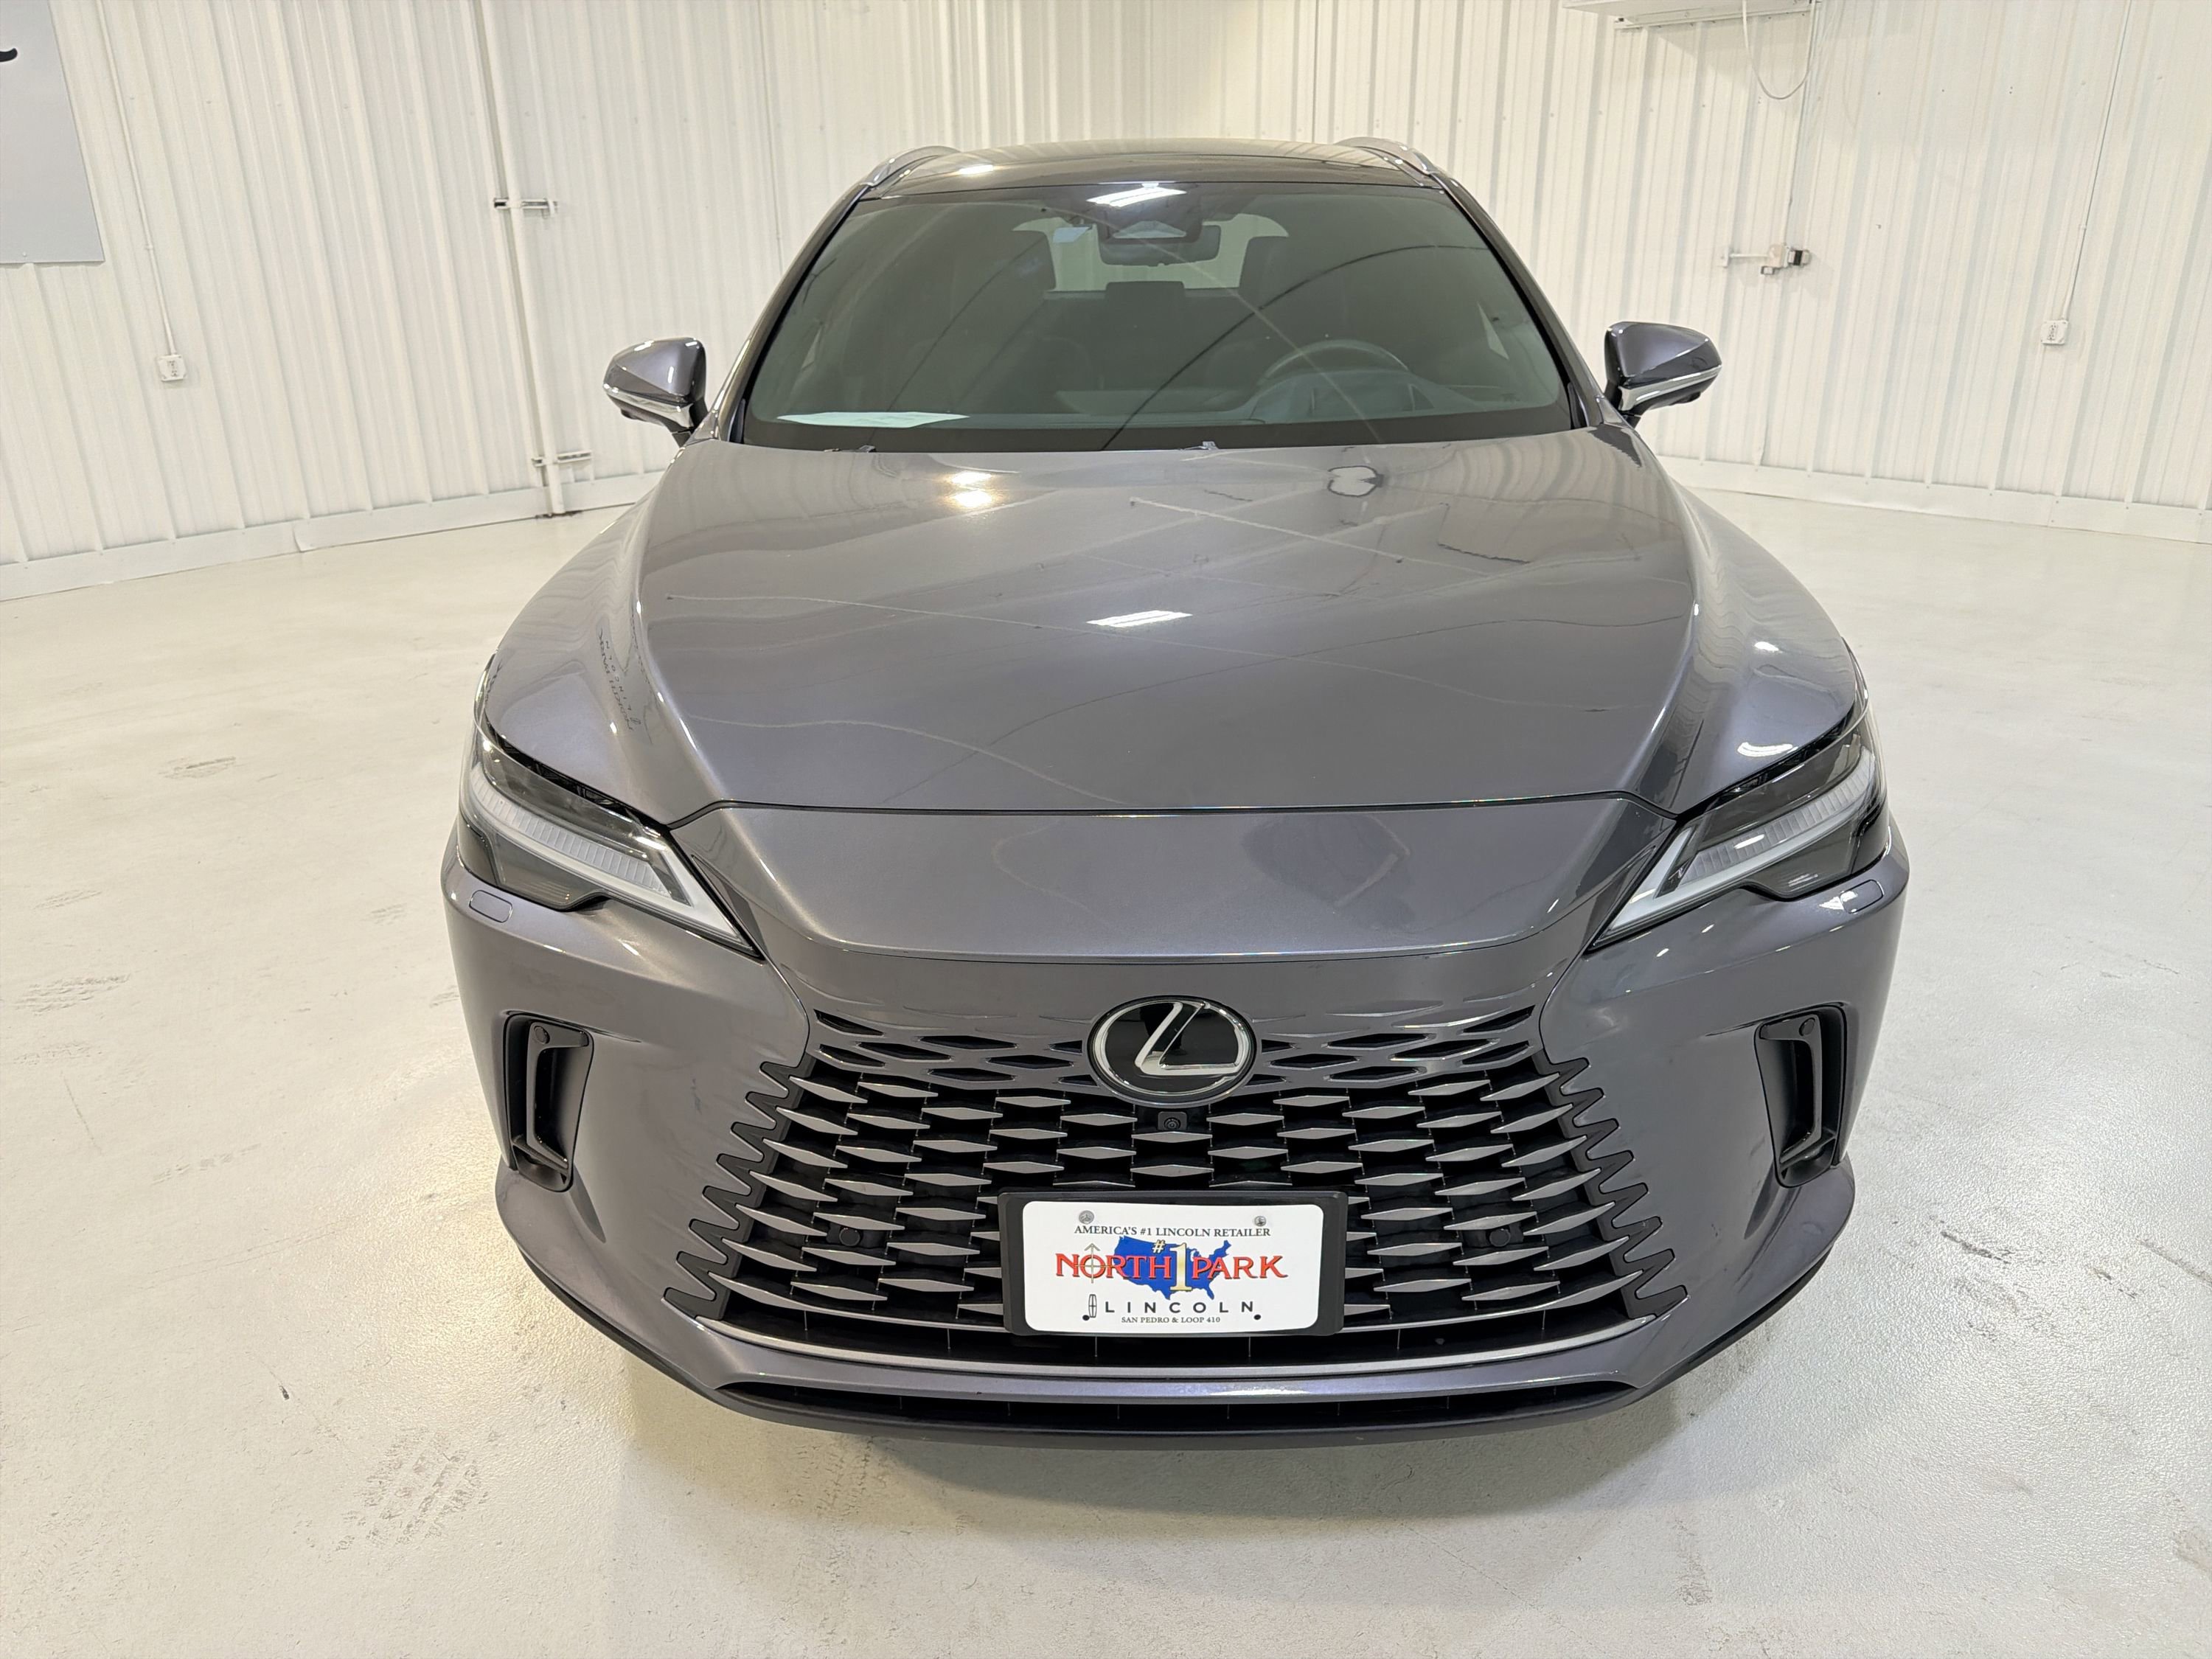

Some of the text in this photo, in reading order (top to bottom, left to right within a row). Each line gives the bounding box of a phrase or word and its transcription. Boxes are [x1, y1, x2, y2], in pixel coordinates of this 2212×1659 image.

[1074, 1225, 1270, 1237] AMERICA'S #1 LINCOLN RETAILER
[1055, 1253, 1288, 1279] NORTH PARK
[1105, 1301, 1253, 1313] LINCOLN
